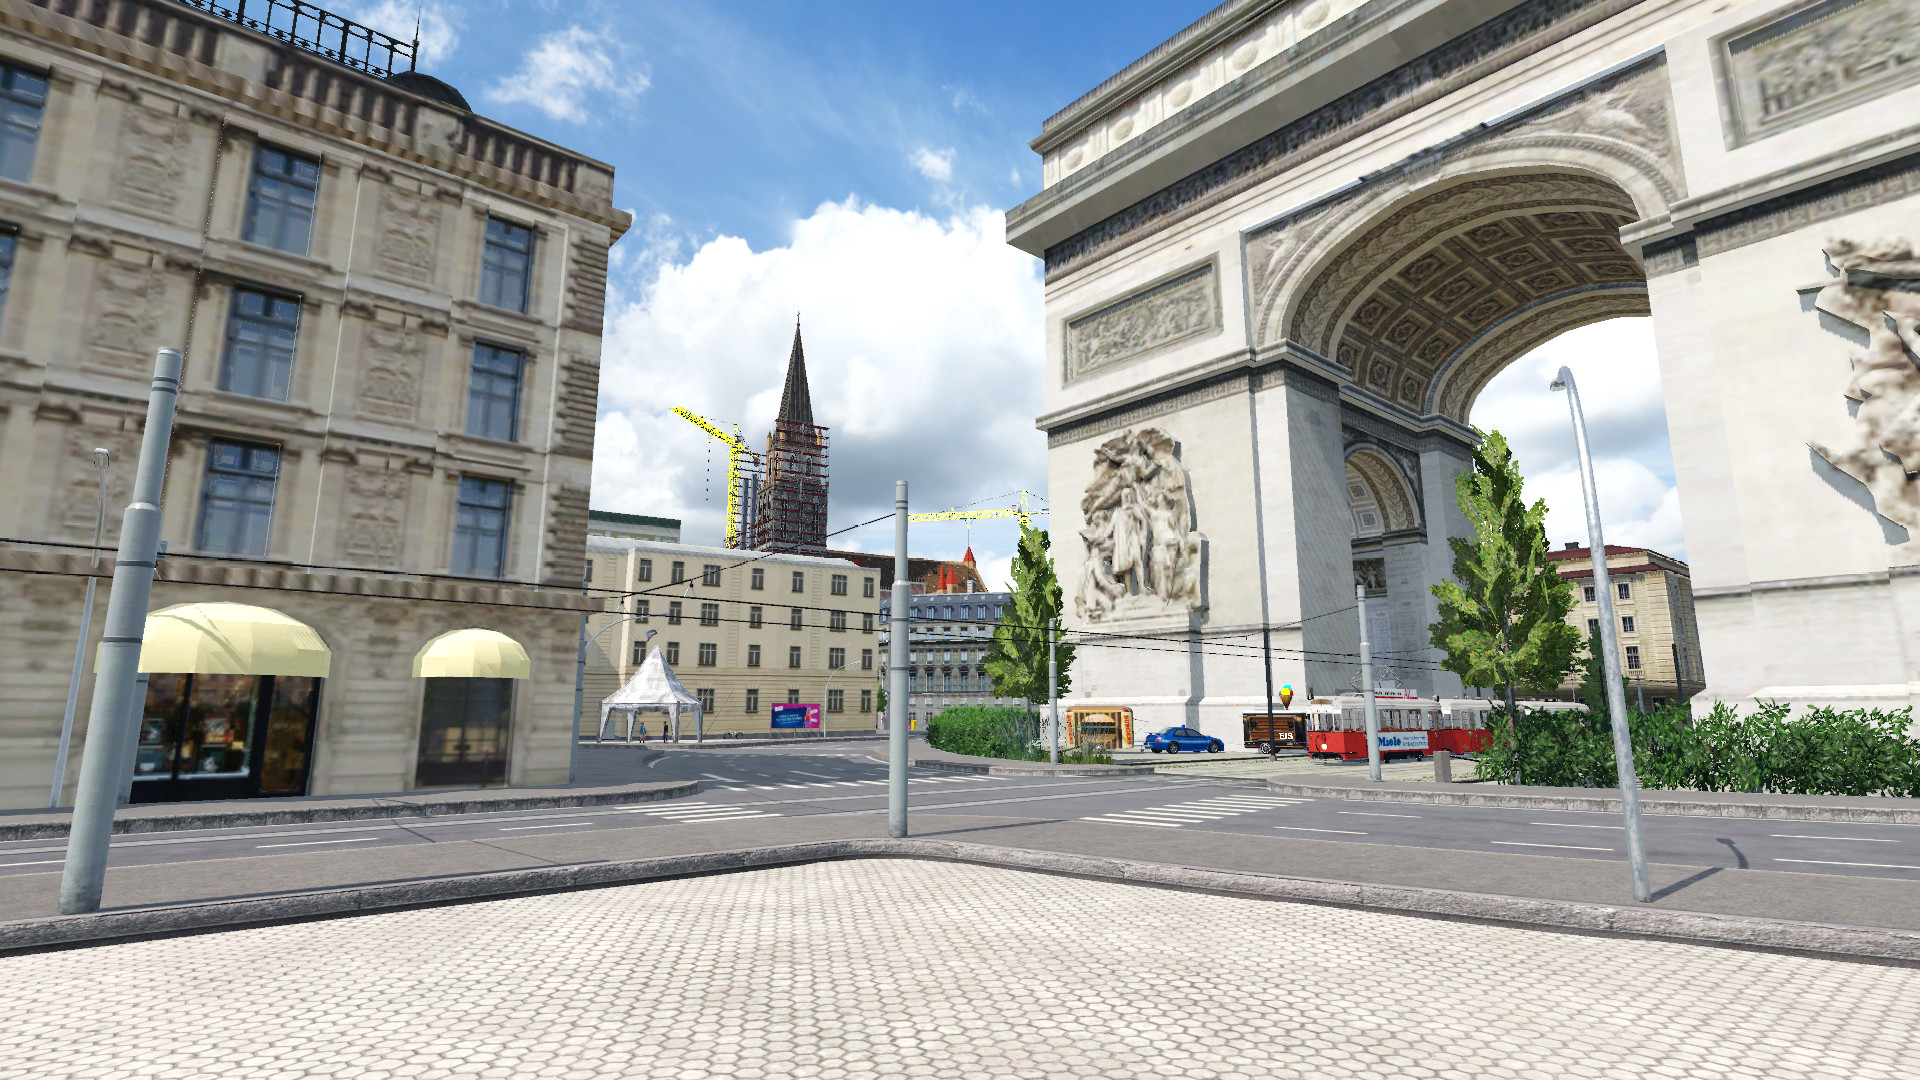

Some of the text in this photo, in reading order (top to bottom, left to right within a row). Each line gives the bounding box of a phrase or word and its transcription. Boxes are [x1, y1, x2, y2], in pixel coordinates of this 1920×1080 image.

[1123, 715, 1132, 745] BURGERS
[1279, 732, 1294, 740] EIS
[1378, 736, 1401, 746] Miele
